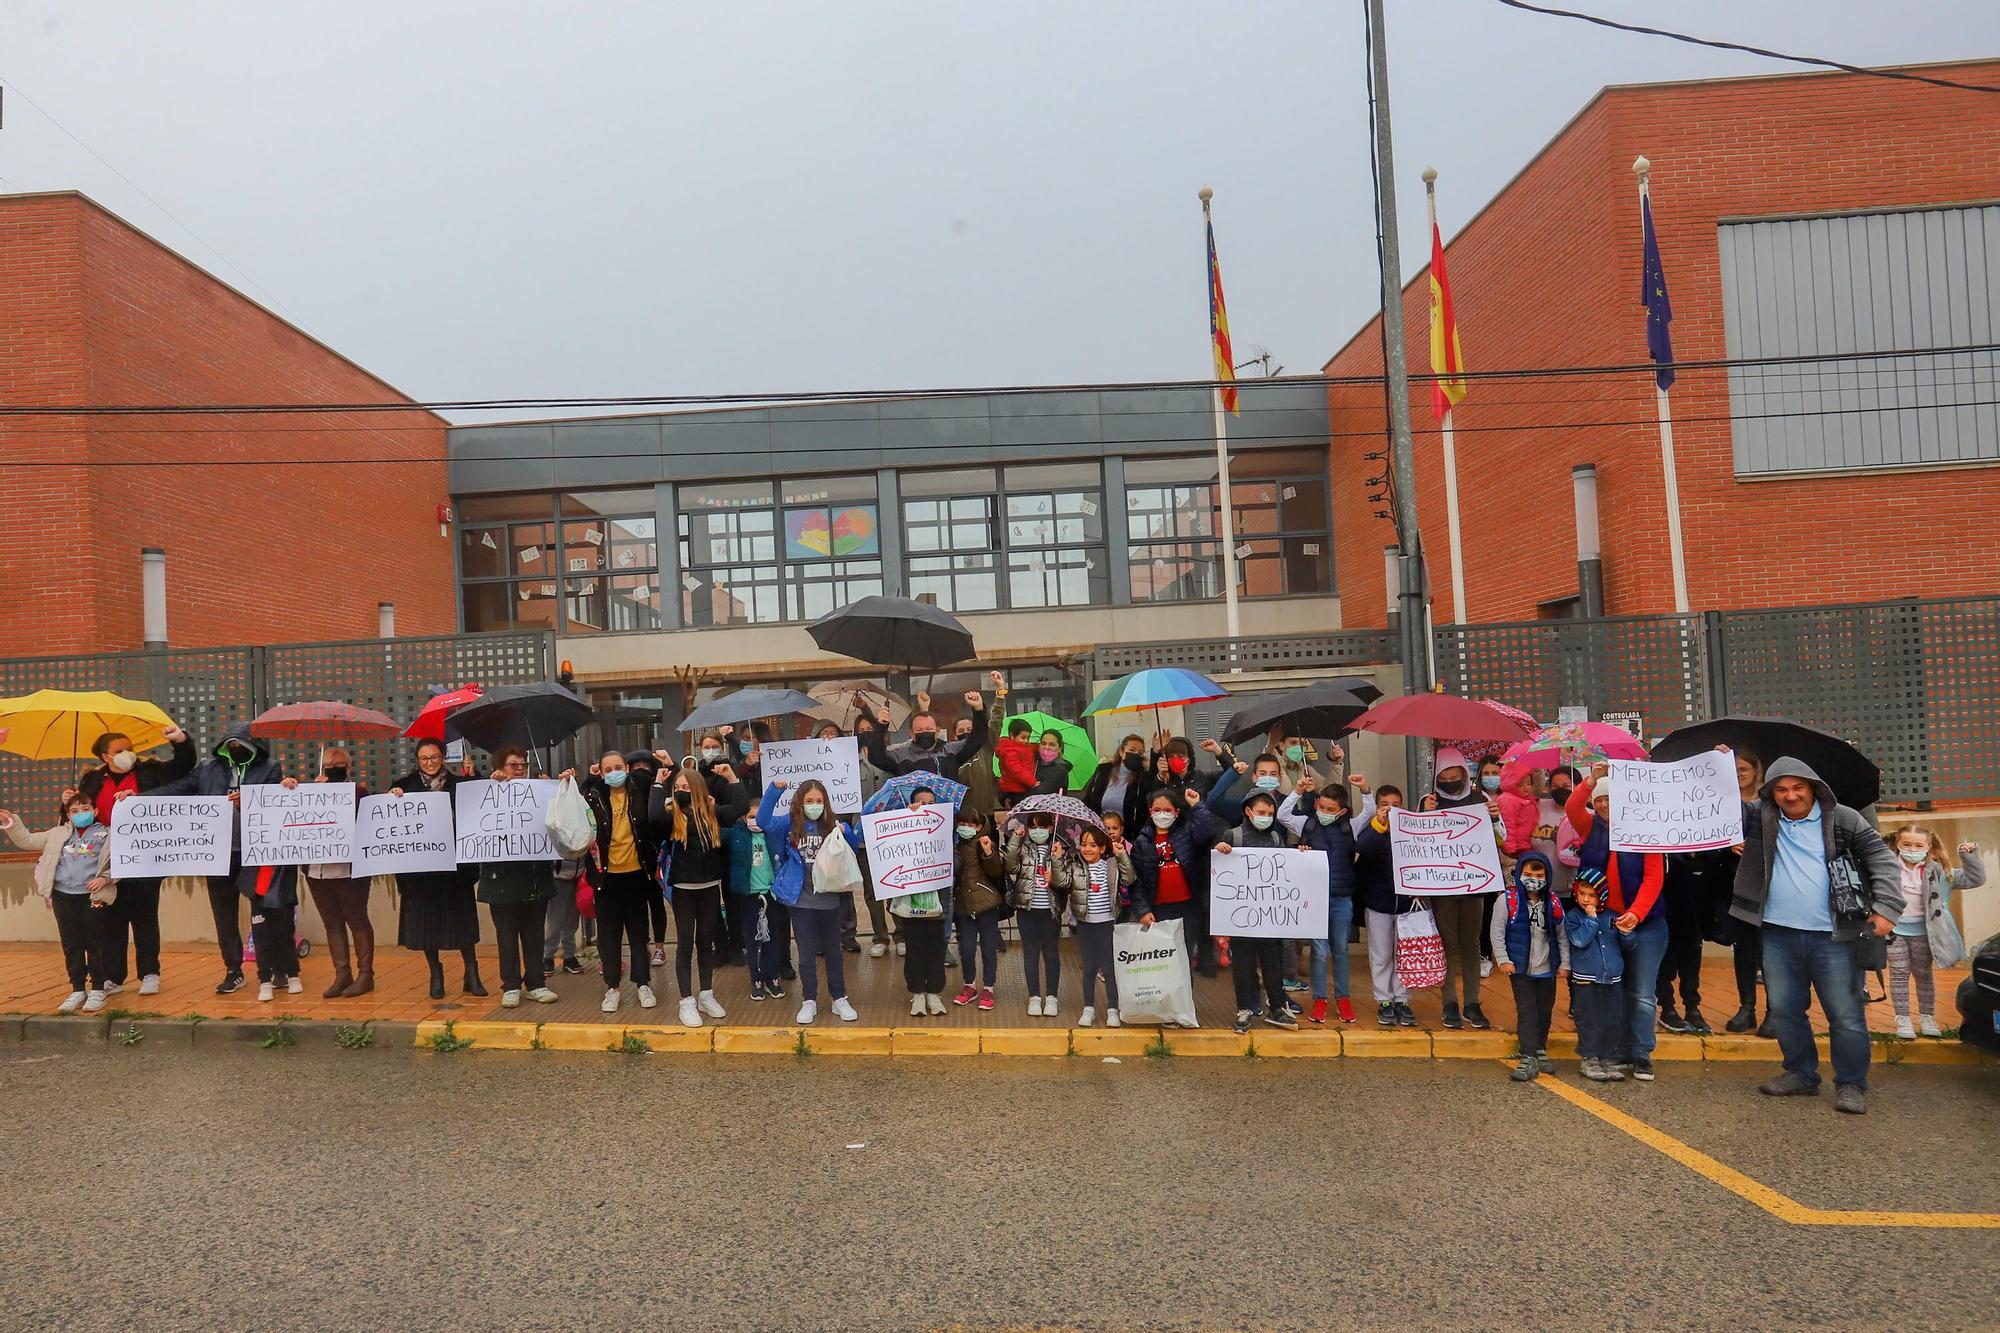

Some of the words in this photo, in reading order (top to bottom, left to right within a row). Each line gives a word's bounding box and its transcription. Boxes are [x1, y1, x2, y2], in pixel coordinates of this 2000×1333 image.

[1602, 711, 1640, 720] CONTROLADA
[766, 747, 792, 760] POR
[817, 745, 832, 755] LA
[768, 762, 834, 778] SEGURIDAD
[844, 762, 850, 773] Y
[1611, 761, 1717, 784] MERECEMOS
[832, 777, 848, 786] DE
[1628, 788, 1665, 805] QUE
[1683, 784, 1717, 803] NOS
[130, 803, 221, 818] QUEREMOS
[1620, 796, 1723, 822] ESCUCHEN
[248, 813, 270, 827] EL
[282, 811, 337, 824] APOYO
[117, 822, 173, 835] CAMBIO
[190, 822, 209, 831] DE
[248, 830, 270, 845] DE
[278, 828, 346, 841] NUESTRO
[130, 833, 215, 850] ADSCRIPCIÓN
[1394, 840, 1482, 859] TORREMENDO
[245, 842, 350, 864] AYUNTAMIENTO
[361, 841, 447, 859] TORREMENDO
[119, 855, 140, 865] DE
[154, 853, 215, 863] INSTITUTO
[1240, 853, 1290, 883] POR
[1403, 869, 1420, 880] SAN
[893, 873, 913, 884] SAN
[1117, 948, 1177, 964] Sprinter
